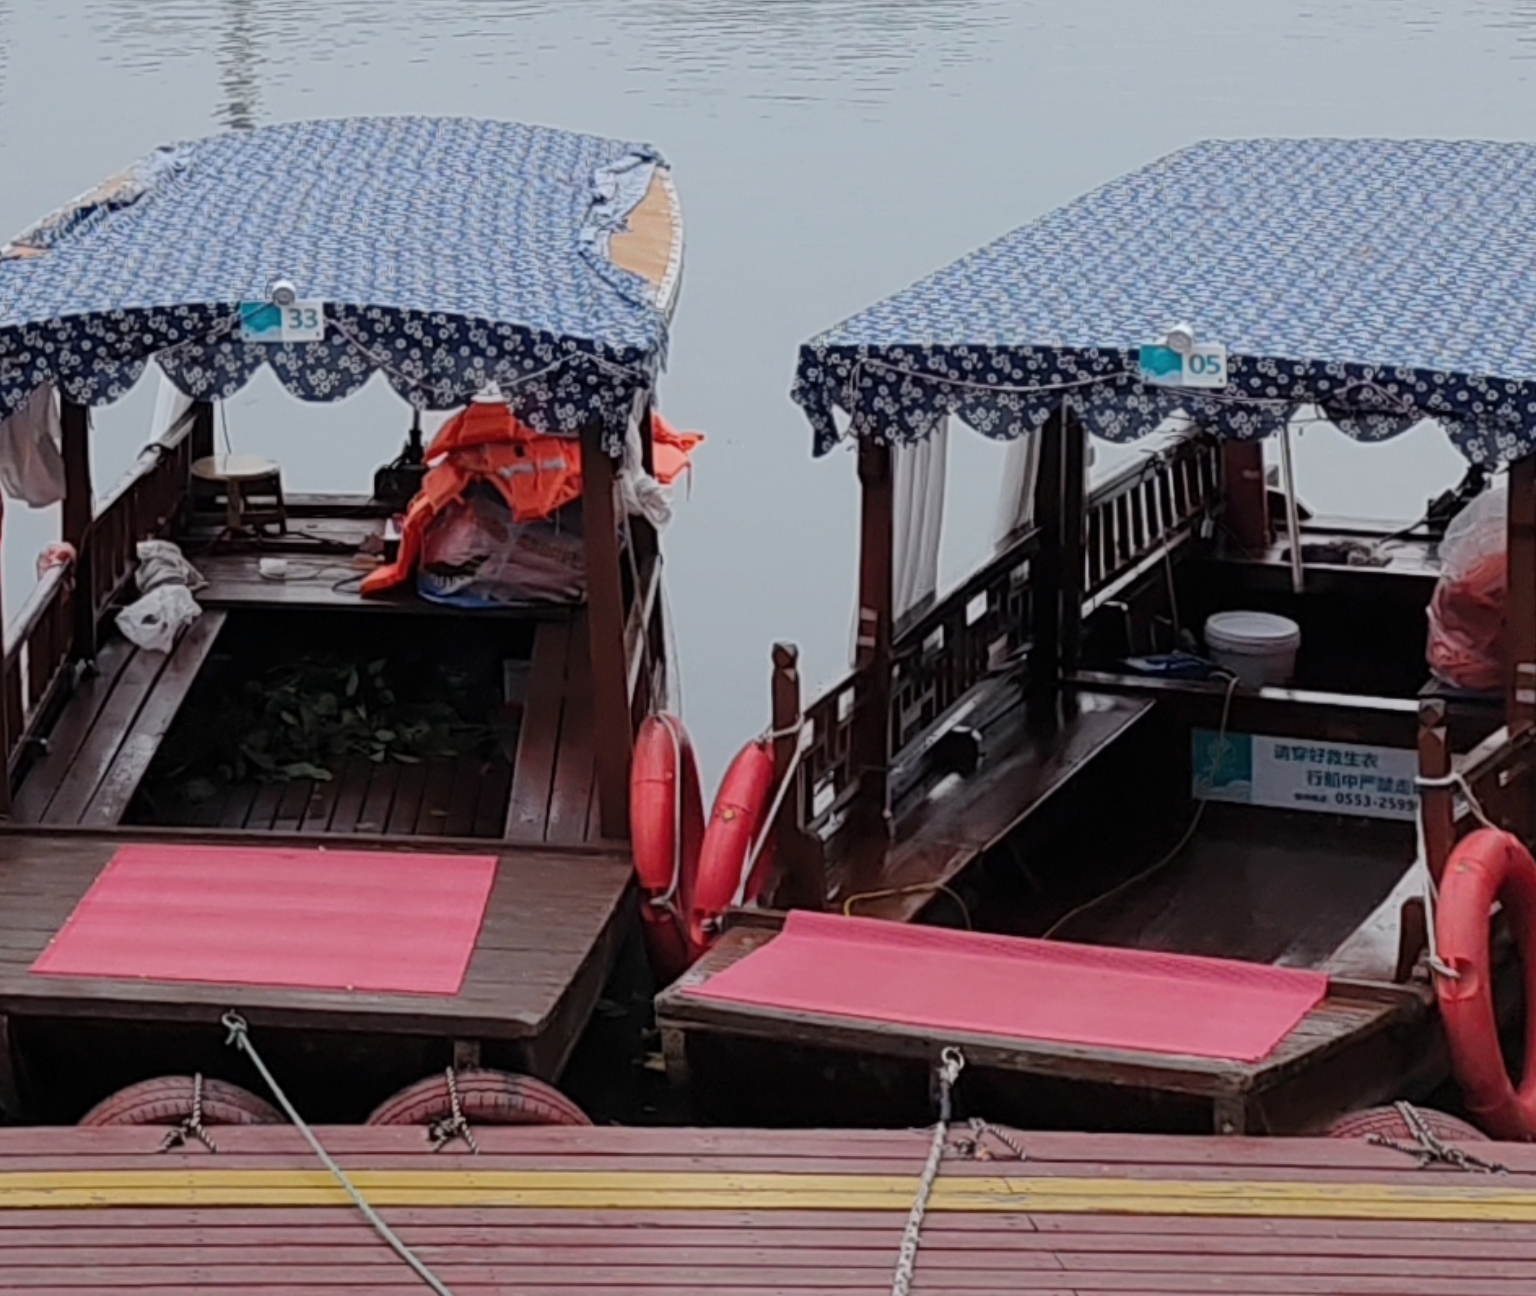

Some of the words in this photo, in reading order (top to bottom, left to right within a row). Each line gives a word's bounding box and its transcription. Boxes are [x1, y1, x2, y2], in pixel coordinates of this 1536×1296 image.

[288, 308, 317, 329] 33
[1188, 354, 1221, 375] 05
[1274, 745, 1378, 768] 请穿好救生衣
